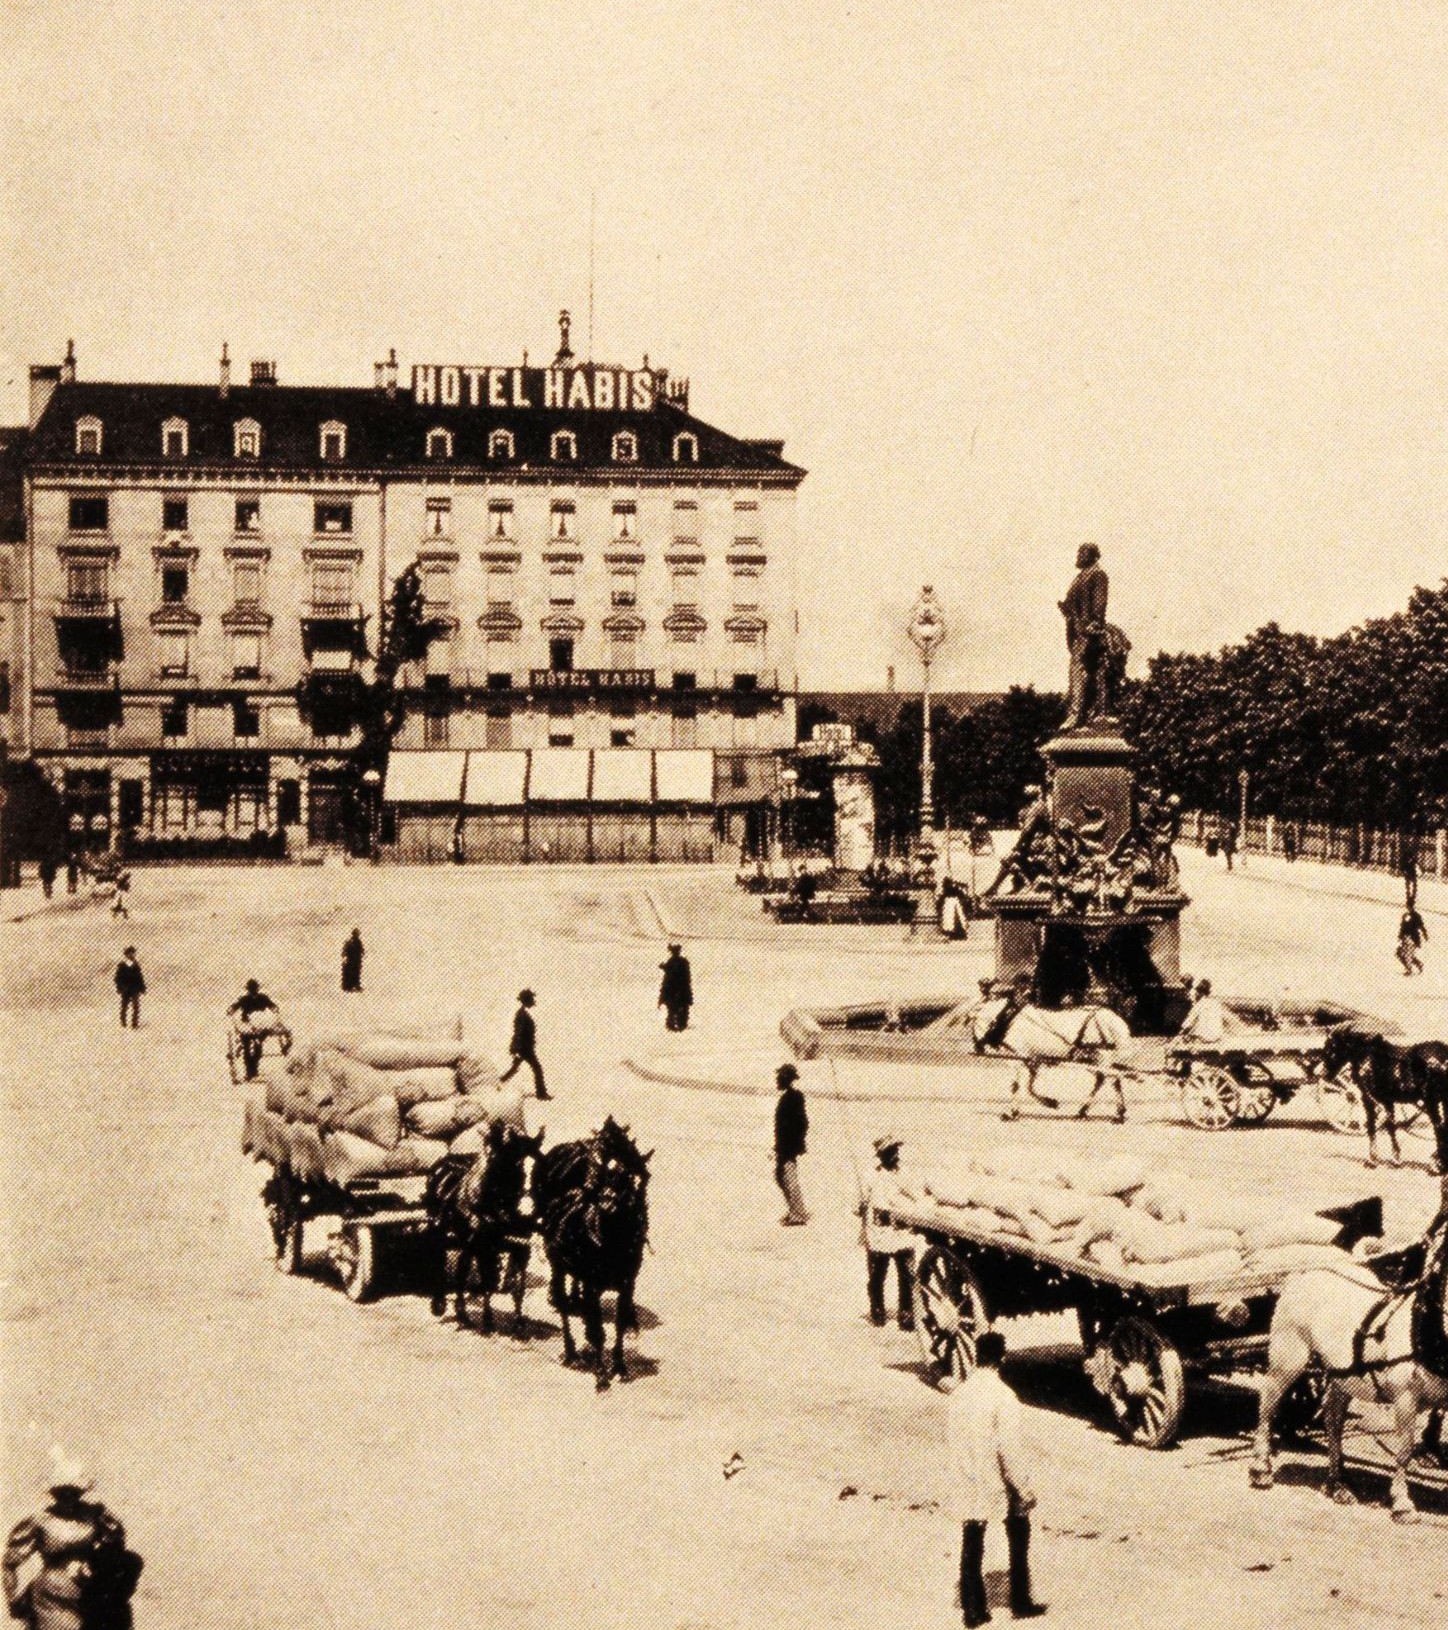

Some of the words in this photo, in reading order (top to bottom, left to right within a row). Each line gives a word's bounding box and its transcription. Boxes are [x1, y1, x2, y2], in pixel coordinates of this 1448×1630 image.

[414, 366, 531, 407] HOTEL
[543, 369, 654, 411] HABIS
[534, 671, 591, 687] HOTEL
[599, 672, 651, 687] HABIS
